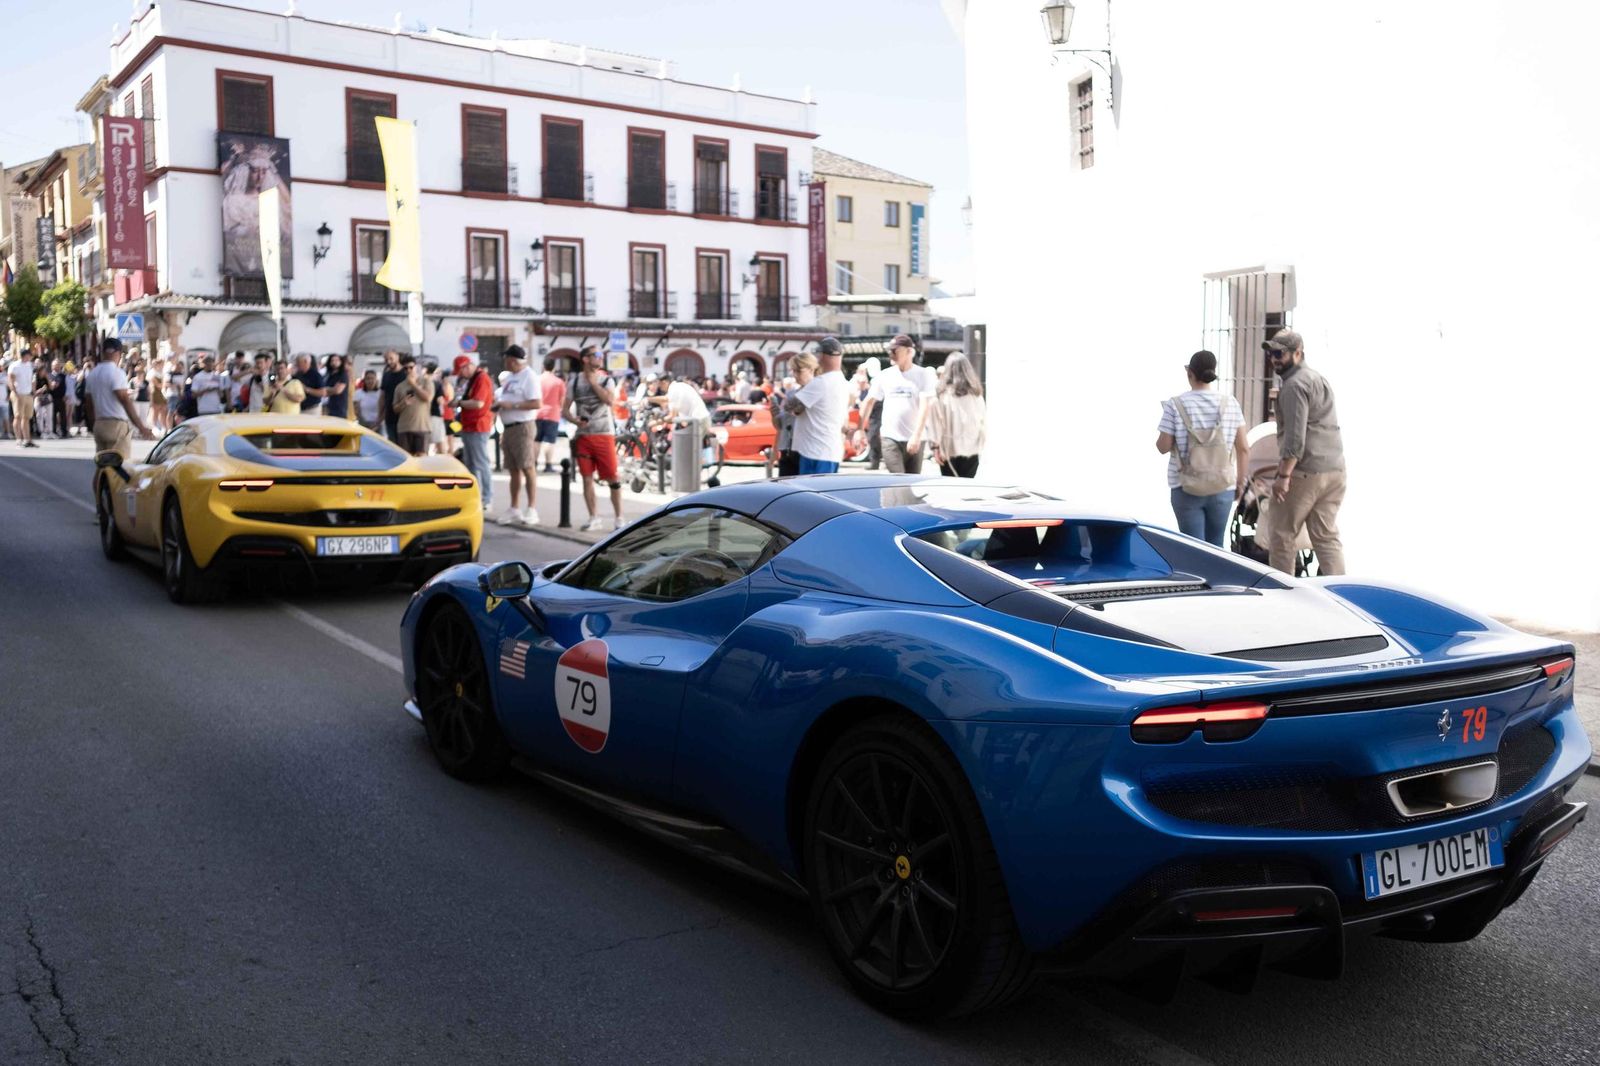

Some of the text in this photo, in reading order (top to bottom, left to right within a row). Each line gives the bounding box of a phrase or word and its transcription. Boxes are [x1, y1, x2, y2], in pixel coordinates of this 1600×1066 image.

[368, 489, 384, 502] 77
[566, 675, 597, 716] 79
[1461, 706, 1487, 744] 79
